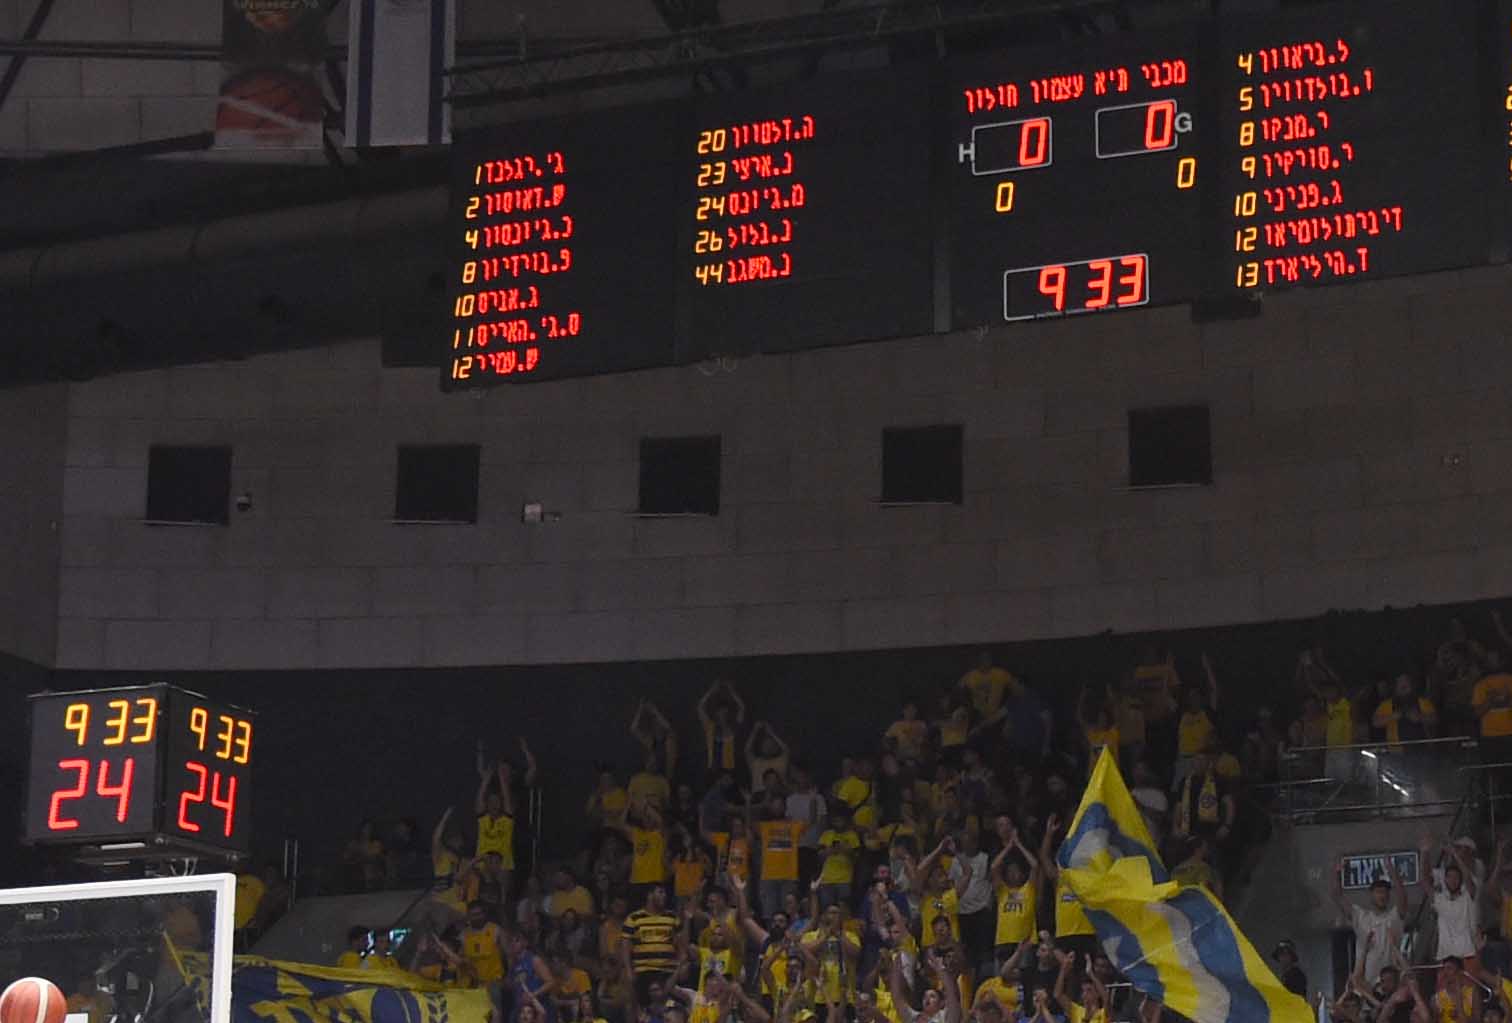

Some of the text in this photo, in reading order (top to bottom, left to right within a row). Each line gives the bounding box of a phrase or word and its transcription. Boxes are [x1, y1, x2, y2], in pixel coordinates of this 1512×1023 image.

[1141, 60, 1187, 88] מכבי
[1239, 53, 1253, 75] 4
[964, 73, 1084, 113] עצמון חולון
[1240, 86, 1253, 111] 5
[1146, 101, 1174, 149] 0
[1173, 112, 1192, 132] G
[1240, 121, 1255, 147] 8
[697, 129, 726, 154] 20
[957, 143, 975, 164] H
[1019, 119, 1048, 167] 0
[475, 165, 482, 185] 1
[697, 161, 726, 187] 23
[1178, 158, 1195, 188] 0
[1242, 156, 1256, 179] 9
[465, 196, 480, 219] 2
[696, 196, 725, 221] 24
[996, 182, 1014, 212] 0
[1235, 180, 1343, 217] 10 ג.פניני
[465, 229, 478, 250] 4
[695, 230, 723, 254] 26
[1236, 226, 1258, 252] 12
[462, 261, 477, 284] 8
[695, 263, 723, 286] 44
[1039, 255, 1145, 311] 9 33
[1237, 263, 1259, 288] 13
[454, 294, 475, 317] 10
[453, 327, 474, 349] 11
[452, 356, 473, 379] 12
[65, 698, 157, 746] 9 33
[190, 707, 252, 764] 9 33
[47, 757, 135, 830] 24
[177, 761, 238, 837] 24
